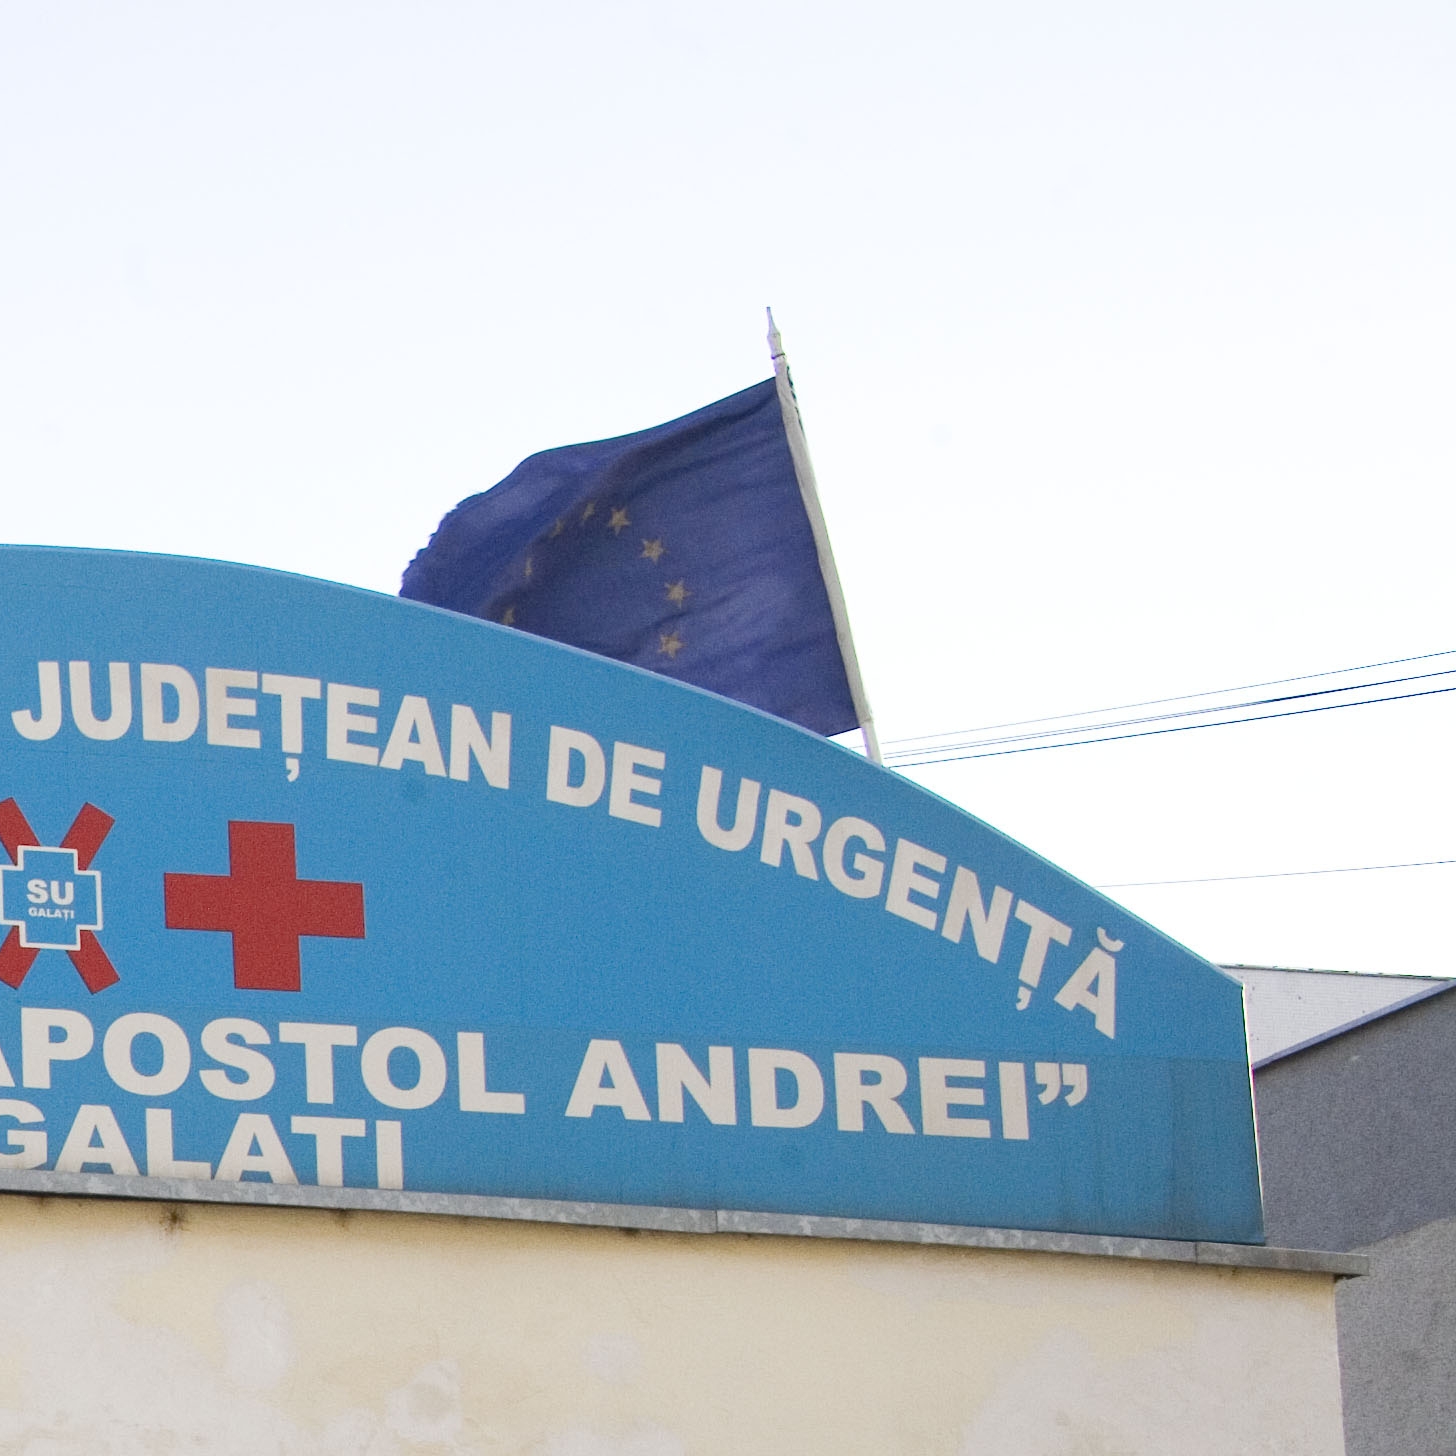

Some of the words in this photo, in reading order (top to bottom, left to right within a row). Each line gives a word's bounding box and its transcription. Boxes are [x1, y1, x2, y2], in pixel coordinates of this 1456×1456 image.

[11, 660, 512, 790] JUDEȚEAN
[546, 725, 666, 828] DE
[26, 878, 75, 906] SU
